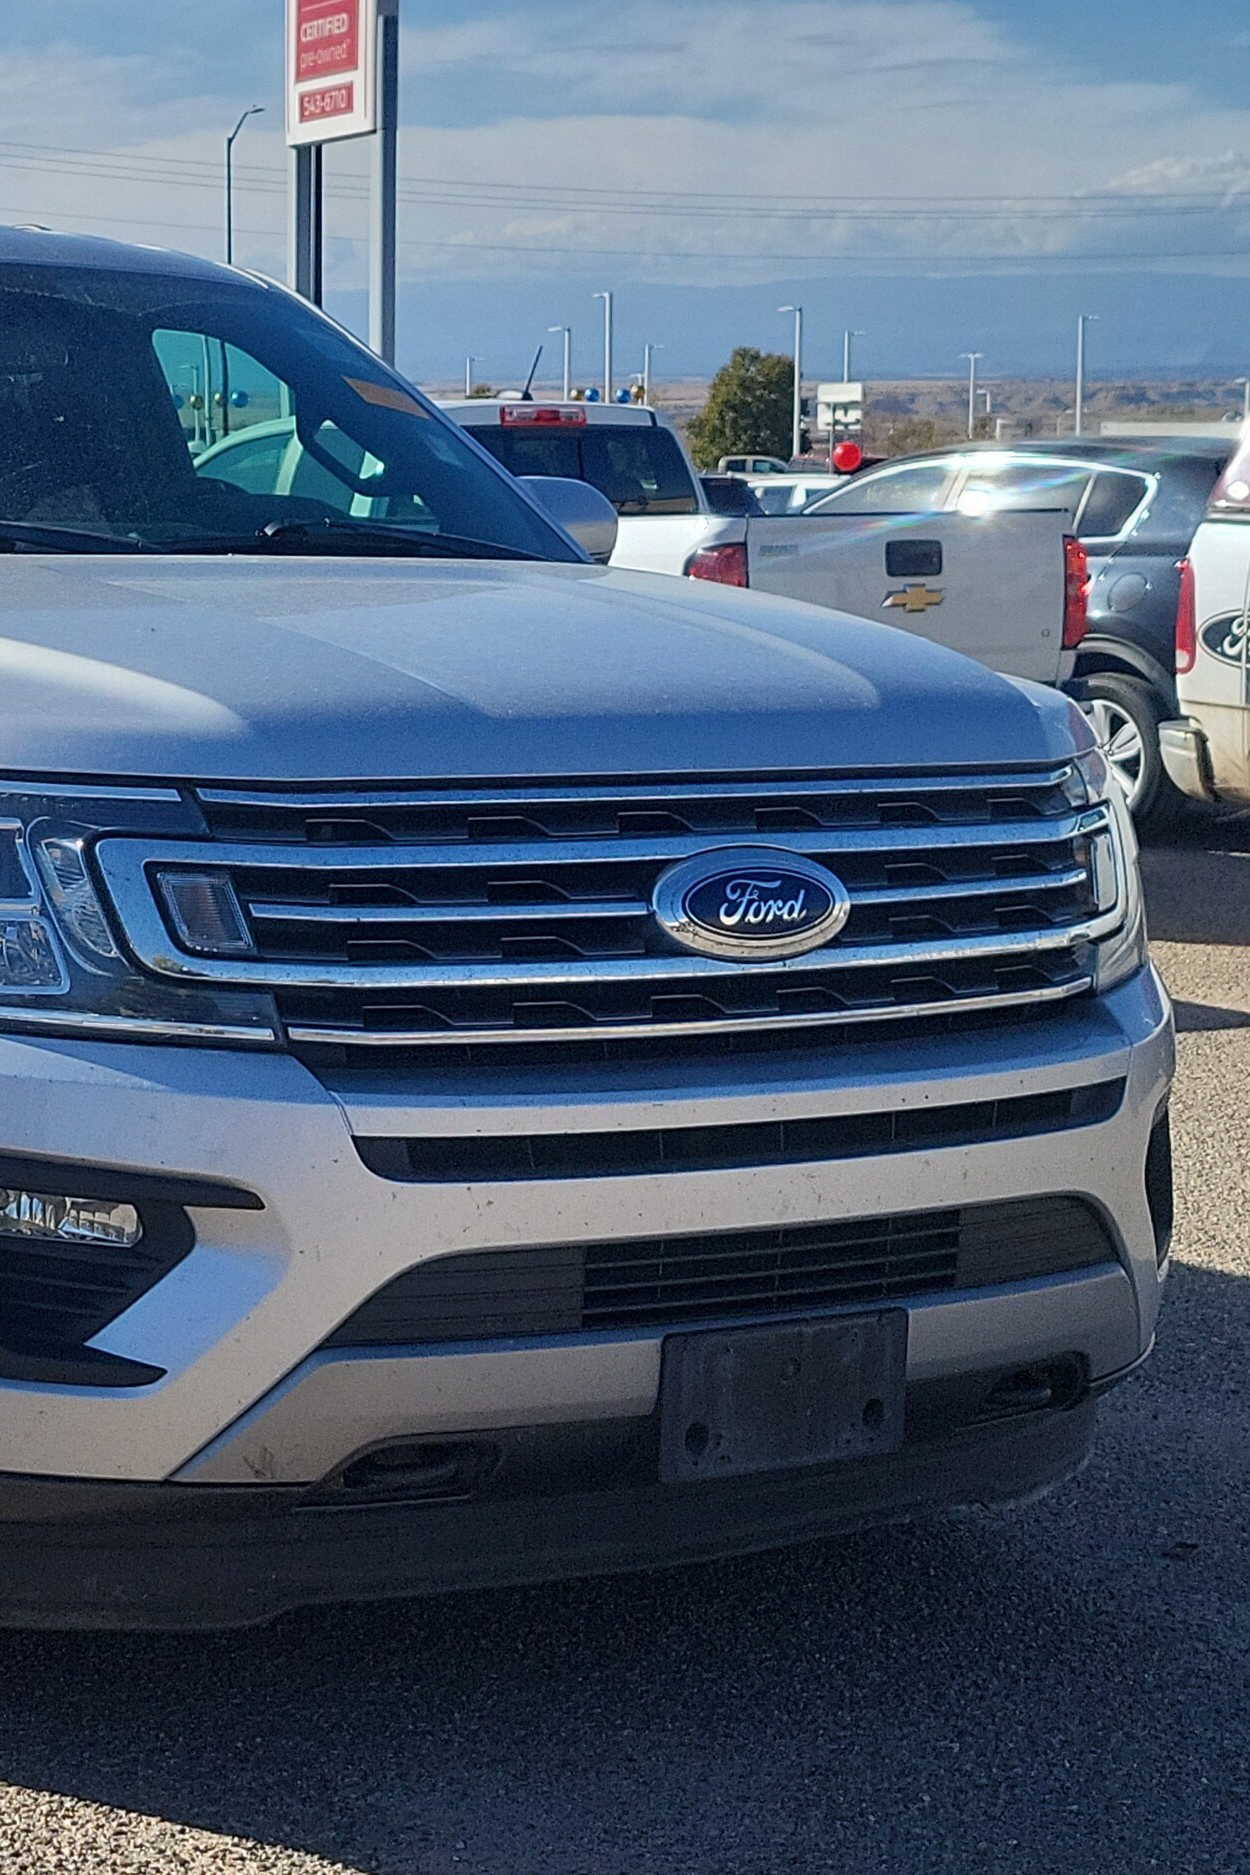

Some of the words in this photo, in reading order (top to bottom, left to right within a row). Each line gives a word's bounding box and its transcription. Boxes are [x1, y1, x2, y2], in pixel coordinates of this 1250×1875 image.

[301, 13, 348, 42] CERTIFIED
[303, 89, 346, 116] 543-6710
[719, 878, 807, 926] Ford
